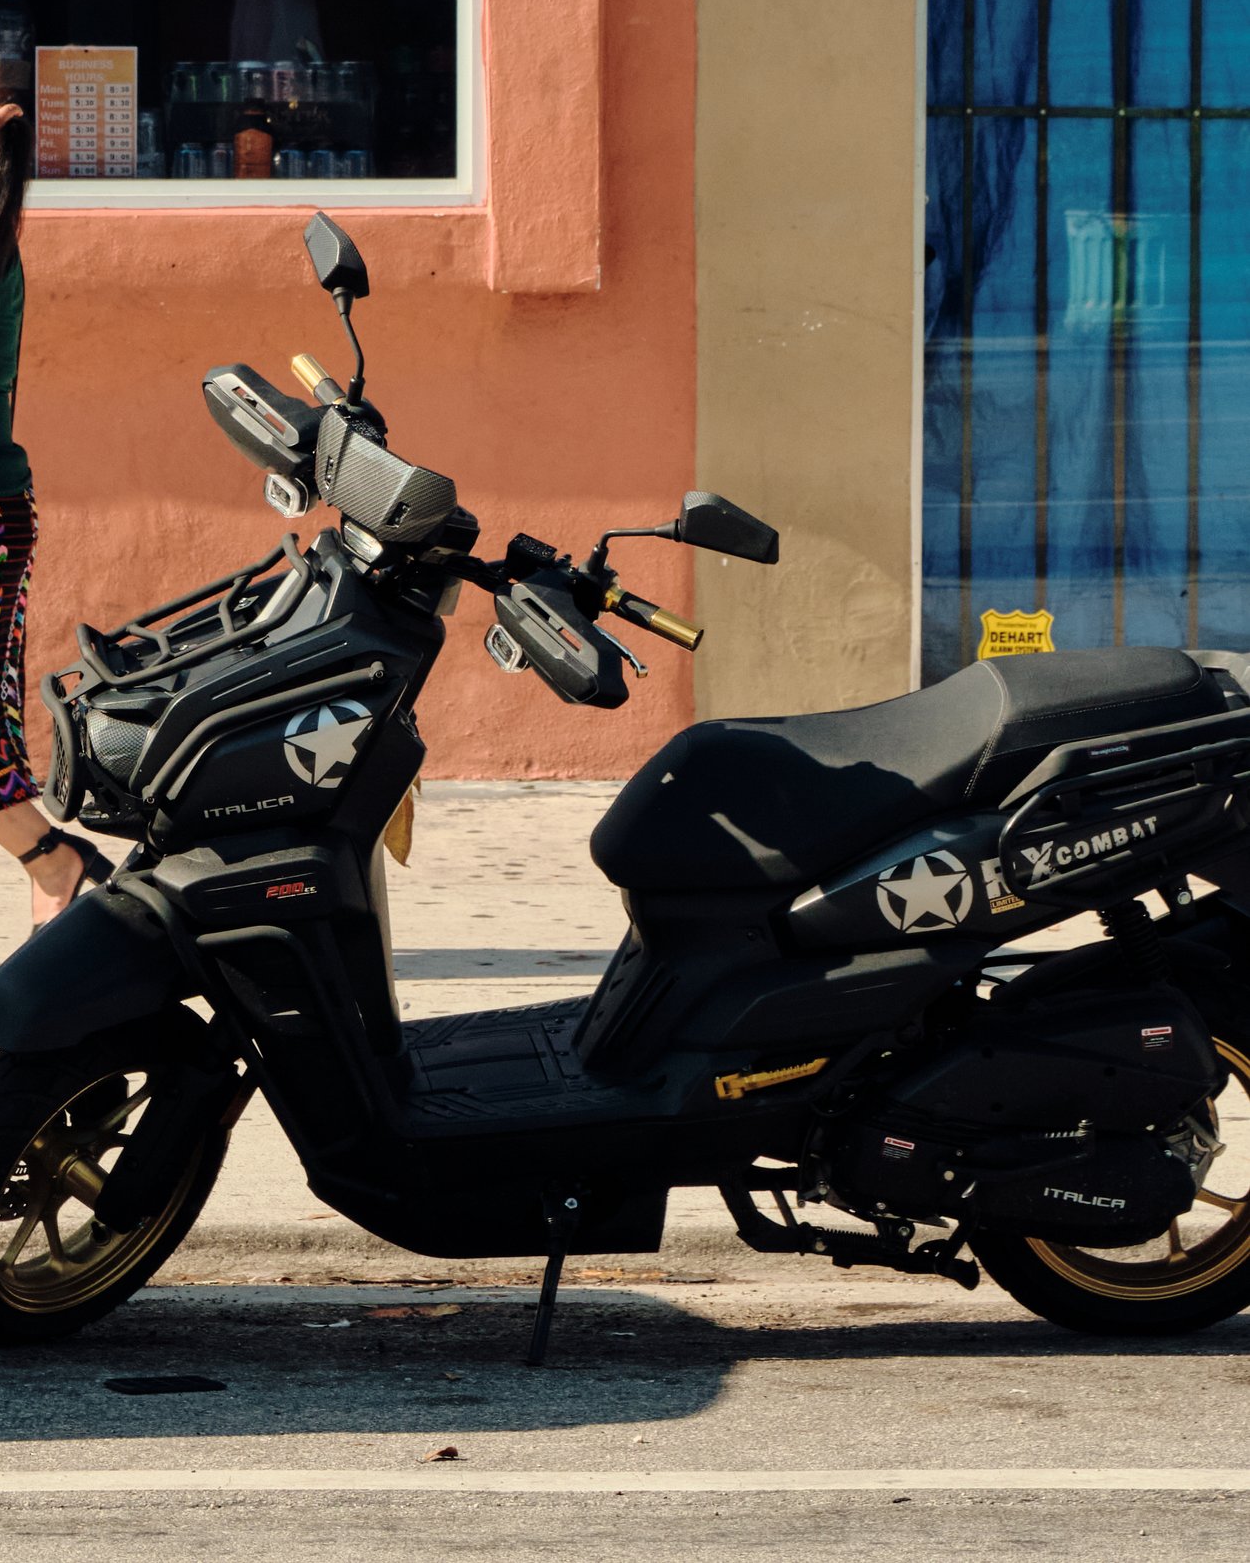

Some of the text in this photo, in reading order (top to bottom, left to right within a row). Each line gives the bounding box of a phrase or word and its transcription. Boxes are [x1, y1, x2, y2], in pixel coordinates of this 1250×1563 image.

[990, 631, 1043, 644] DEHART
[203, 795, 295, 819] ITALICA
[1043, 1187, 1126, 1209] ITALICA
